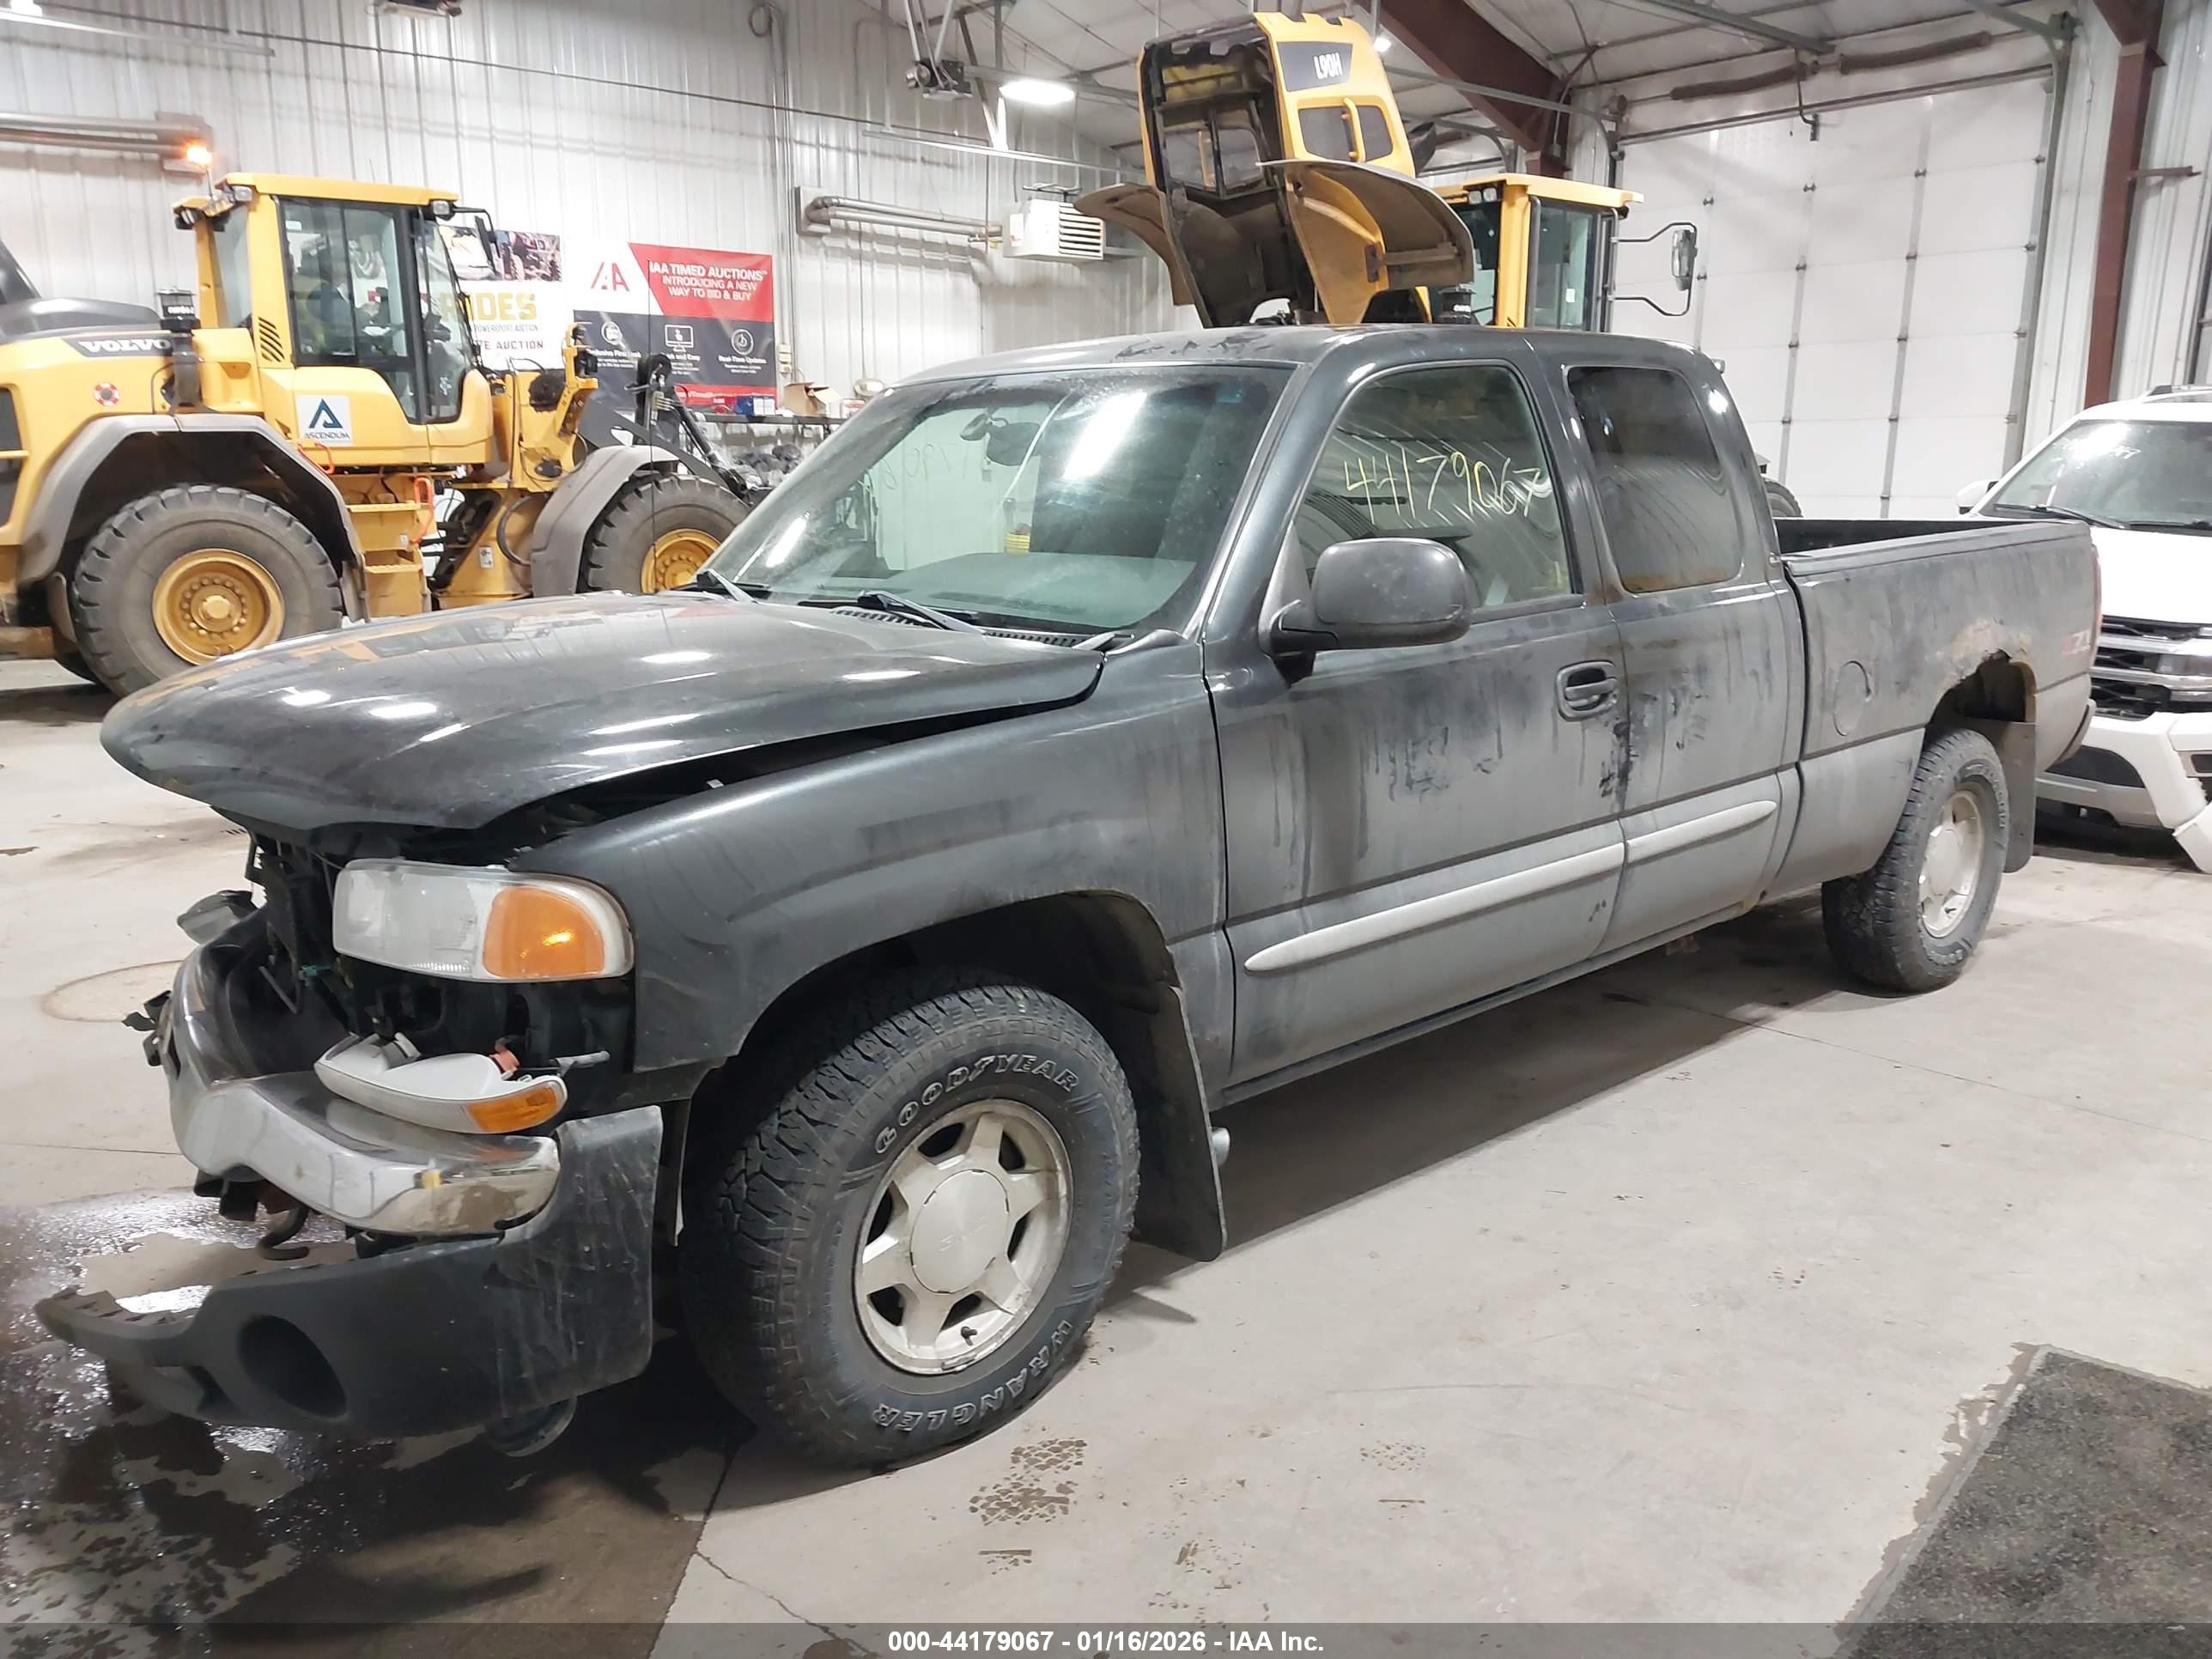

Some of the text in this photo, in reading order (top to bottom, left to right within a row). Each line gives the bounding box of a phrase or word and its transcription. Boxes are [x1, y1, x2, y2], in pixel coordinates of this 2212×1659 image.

[1314, 52, 1342, 79] L90H
[649, 261, 669, 275] IAA
[670, 264, 706, 276] TIMED
[662, 275, 758, 291] INTRODUCING A NEW
[668, 285, 752, 301] WAY TO BID & BUY
[77, 338, 173, 353] VOLVO
[495, 339, 544, 351] AUCTION
[1345, 447, 1542, 526] 44179067
[875, 1054, 1079, 1153] GOODYEAR
[872, 1320, 1073, 1431] WRANGLER
